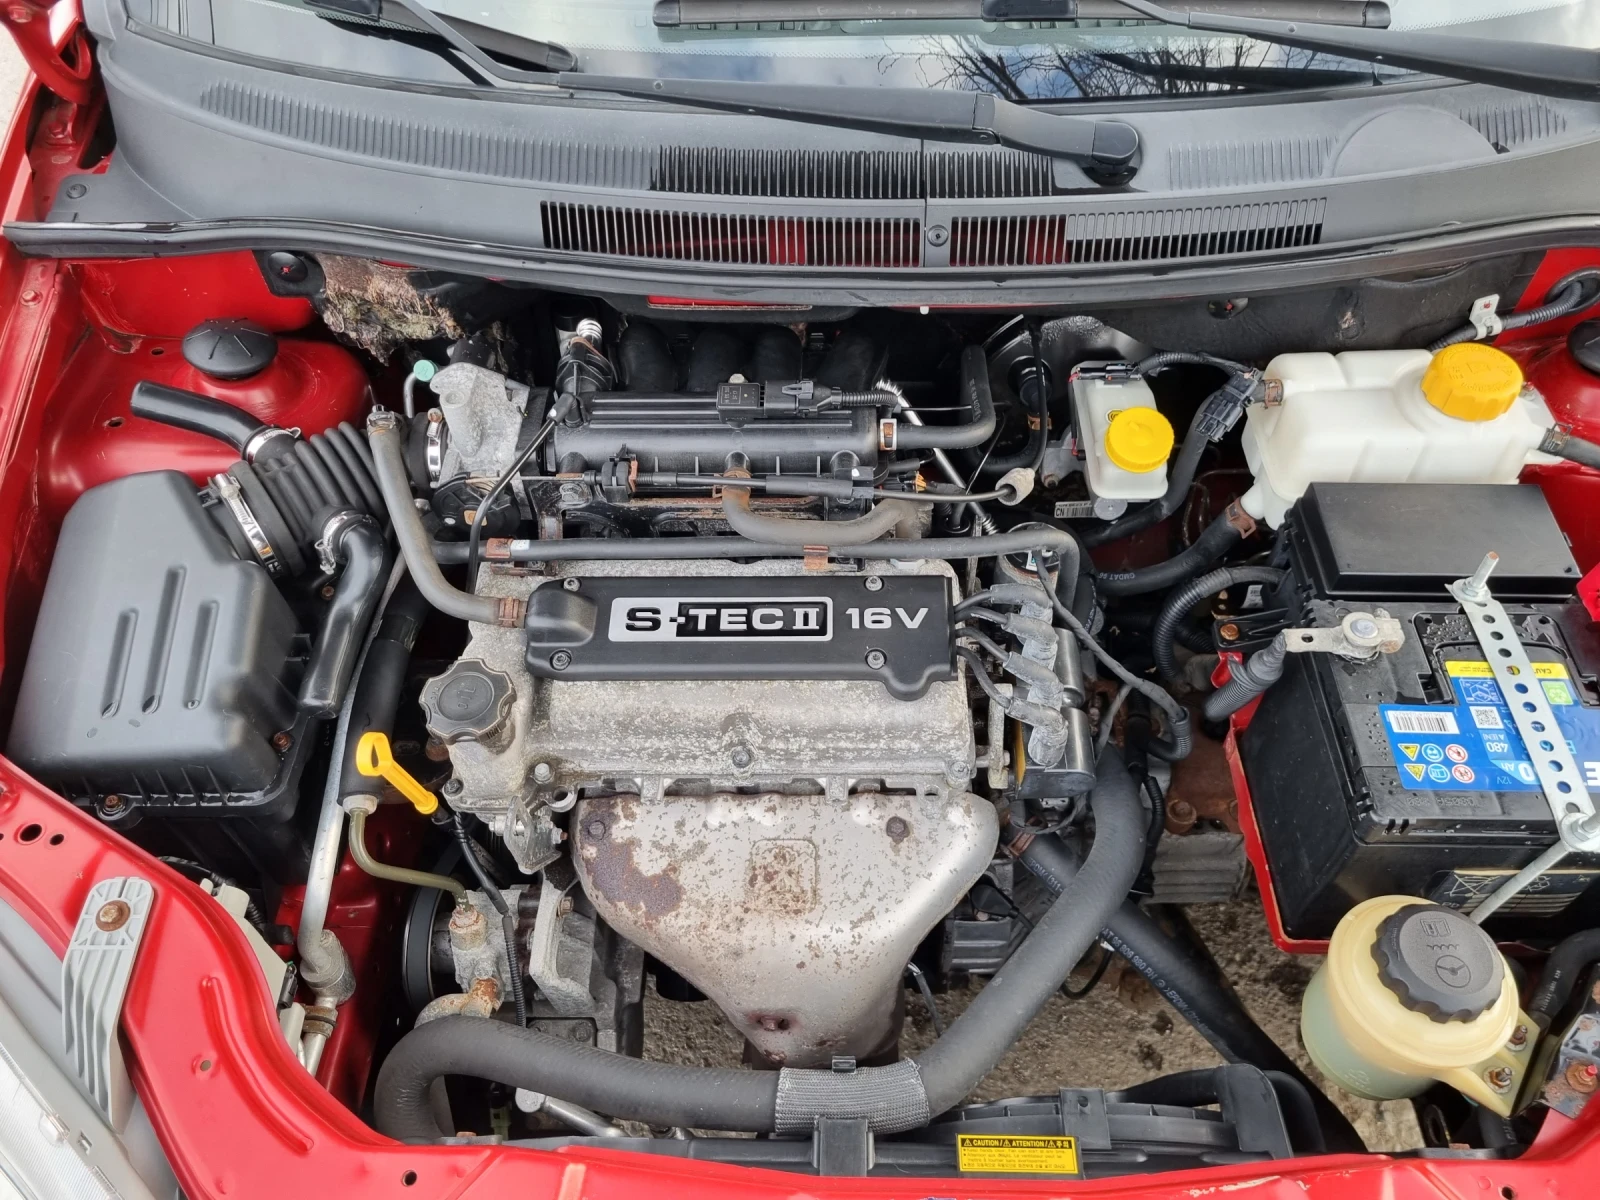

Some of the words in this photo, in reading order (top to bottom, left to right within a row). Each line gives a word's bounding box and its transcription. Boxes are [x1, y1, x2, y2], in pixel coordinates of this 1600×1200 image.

[845, 606, 929, 630] 16V
[1485, 742, 1508, 753] 480
[1496, 776, 1512, 785] 12V
[973, 1139, 999, 1147] CAUTION
[1011, 1140, 1045, 1148] ATTENTION
